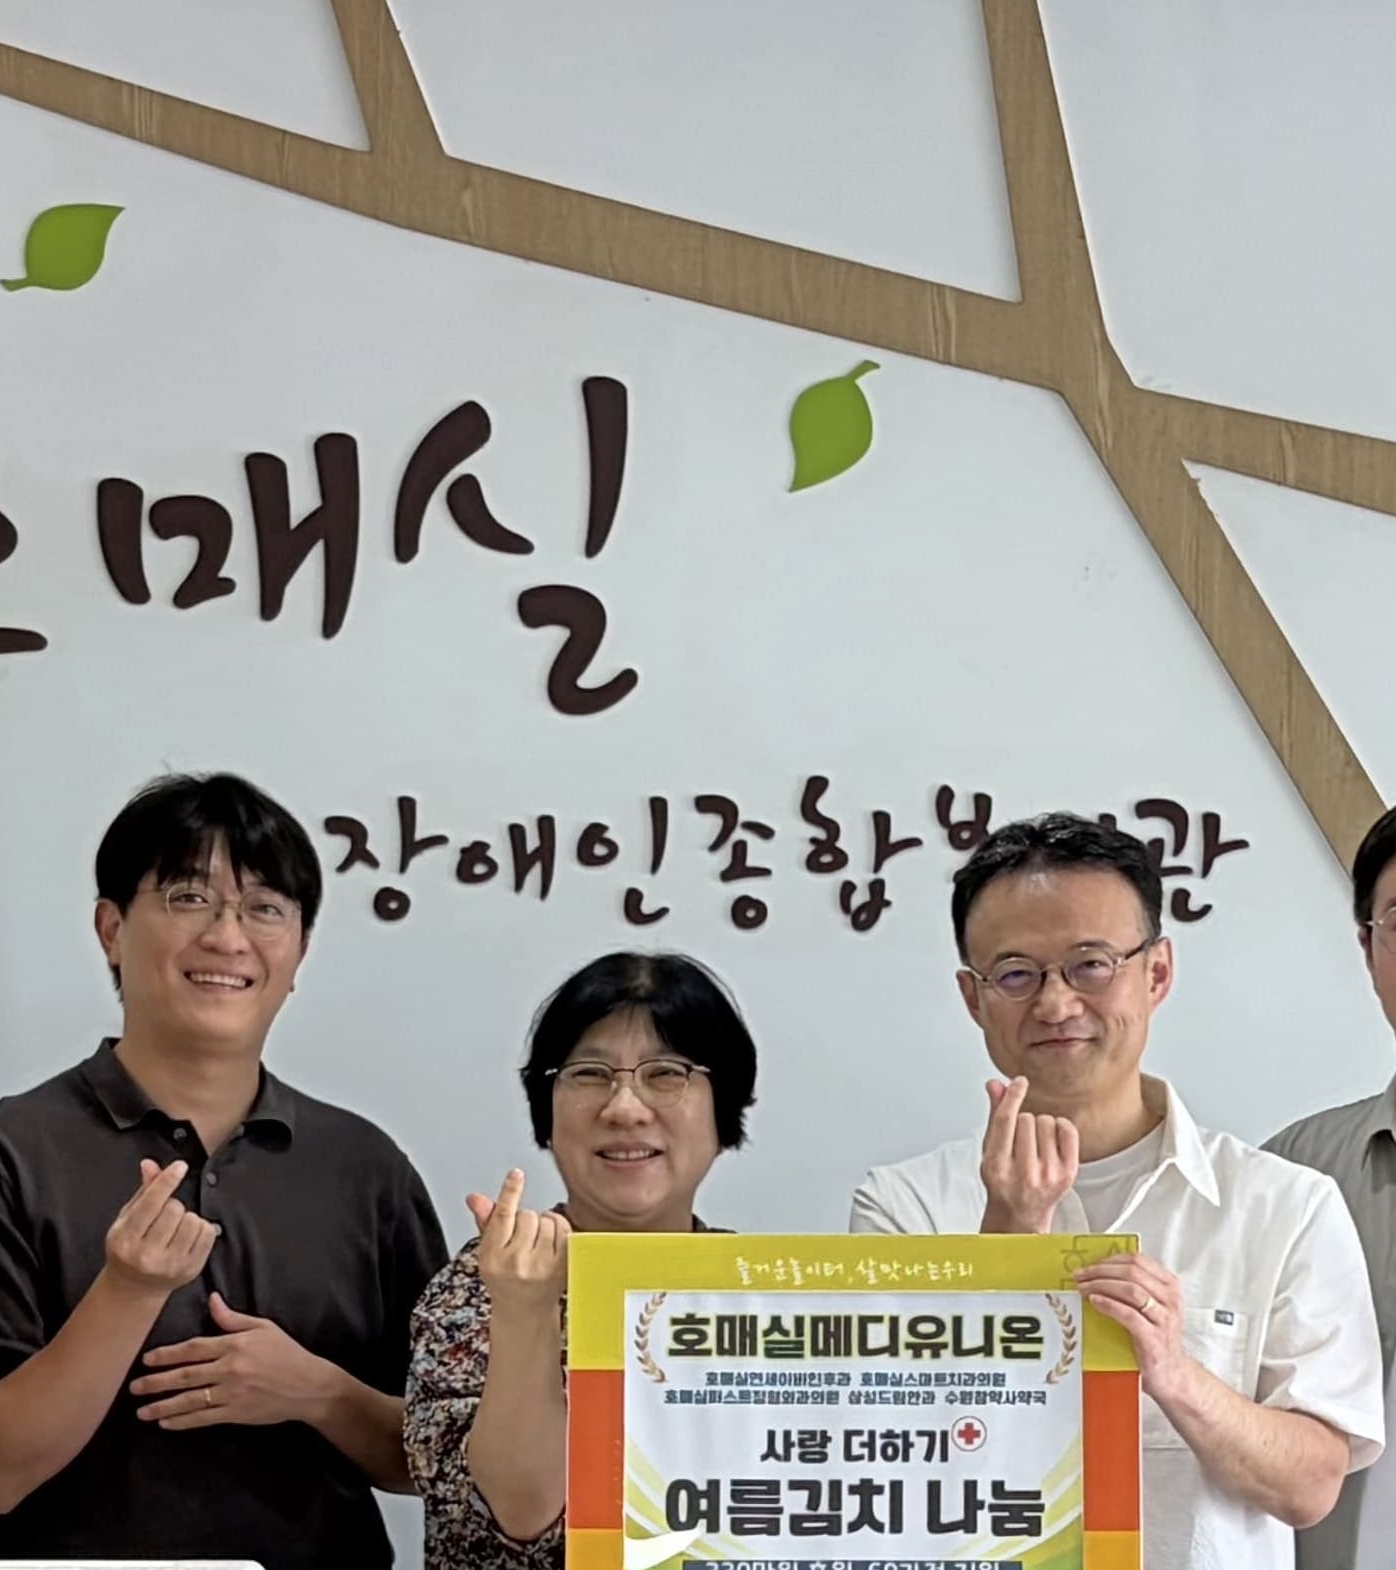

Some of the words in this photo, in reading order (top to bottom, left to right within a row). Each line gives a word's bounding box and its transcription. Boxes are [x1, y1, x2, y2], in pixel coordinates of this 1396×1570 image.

[323, 775, 1250, 933] 장애인종합관
[667, 1312, 1044, 1361] 호매실메디유니온
[760, 1428, 829, 1464] 사랑
[842, 1428, 949, 1464] 더하기
[664, 1478, 904, 1536] 여름김치
[926, 1478, 1045, 1537] 나눔
